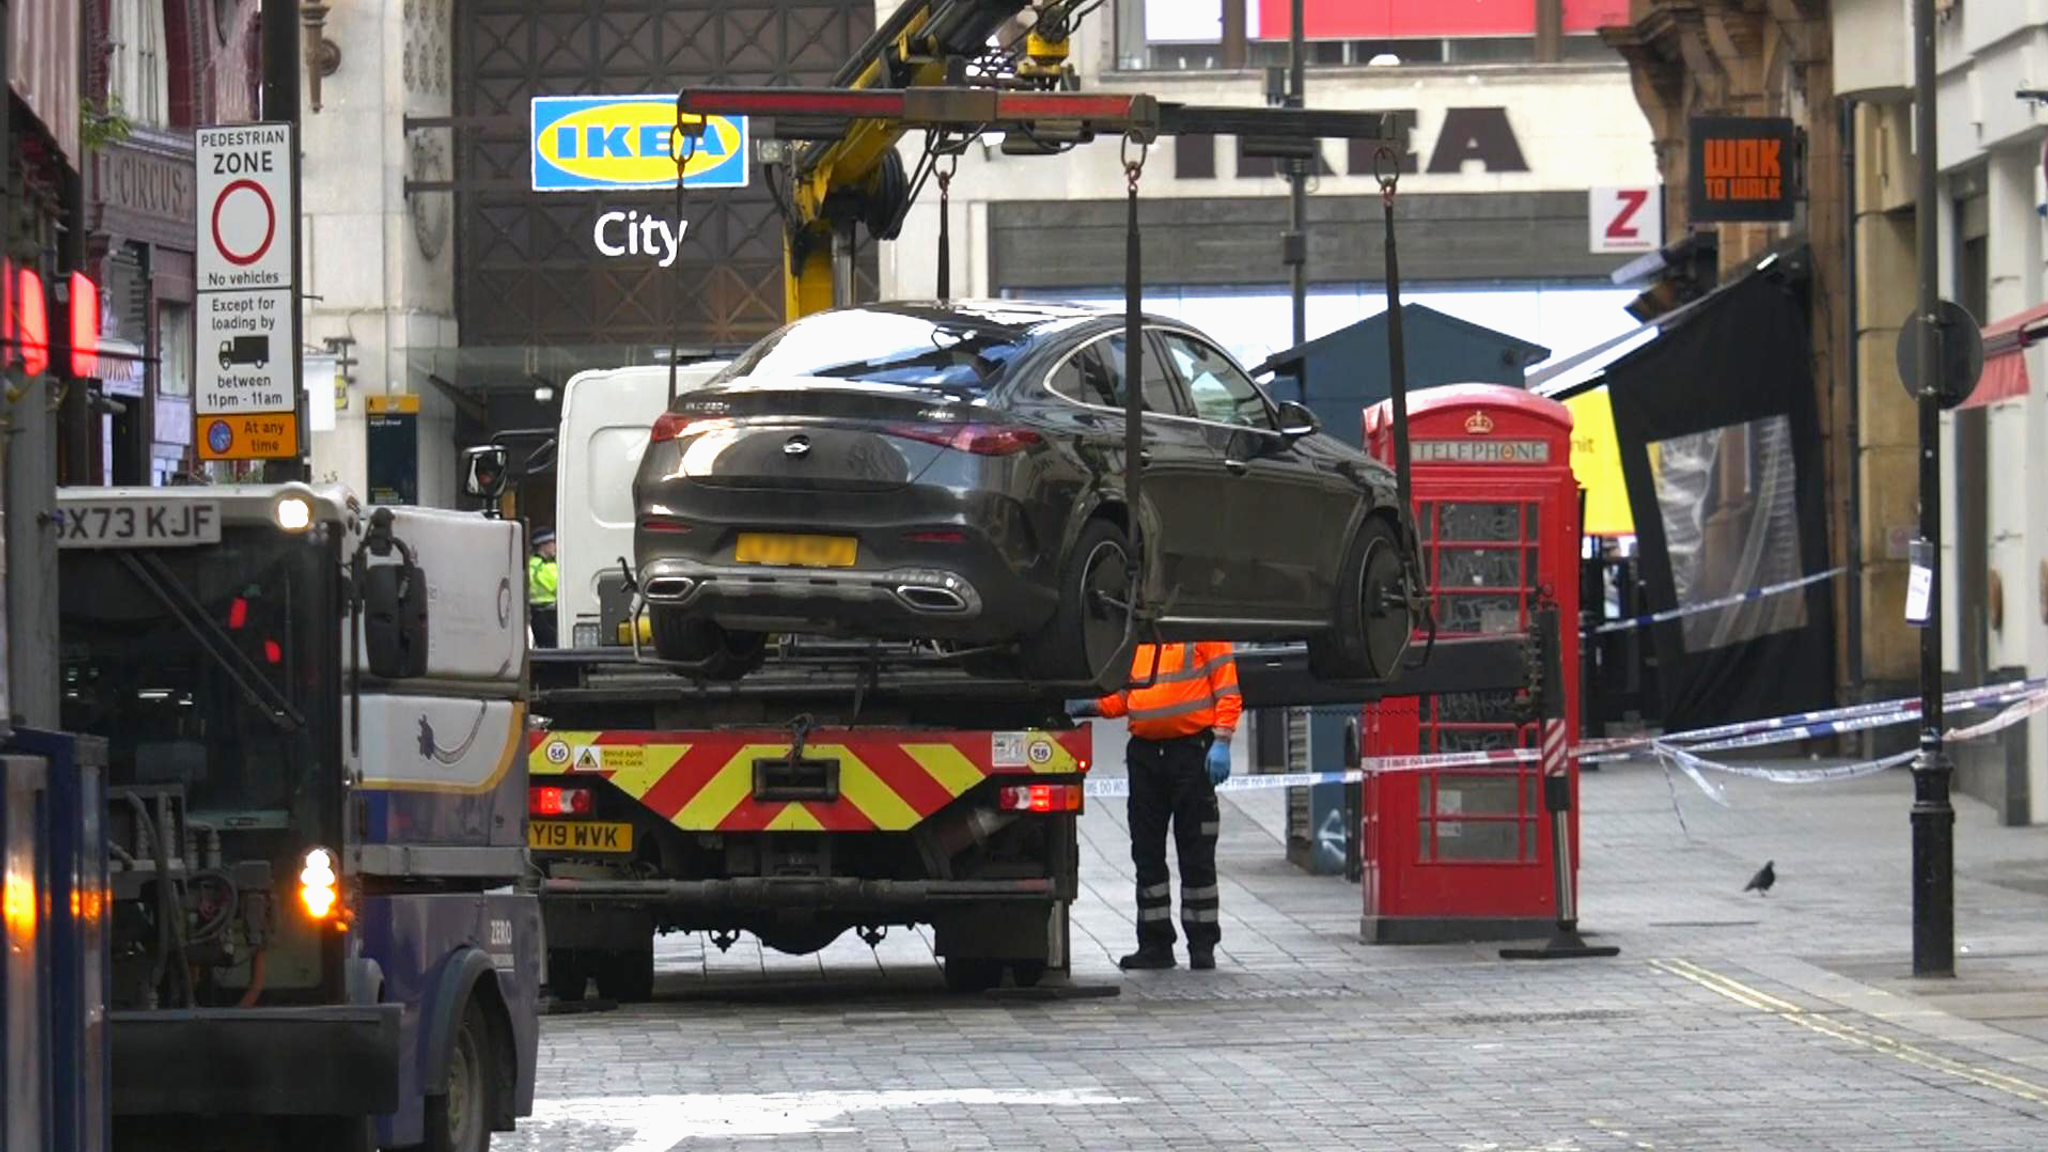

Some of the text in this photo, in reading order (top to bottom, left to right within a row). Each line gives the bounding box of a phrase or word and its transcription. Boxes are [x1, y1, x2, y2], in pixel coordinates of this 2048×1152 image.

[201, 130, 284, 147] PEDESTRIAN
[558, 124, 726, 159] IKEA
[213, 151, 274, 174] ZONE
[1704, 139, 1780, 178] WOK
[1704, 179, 1780, 200] TO WALK
[1605, 191, 1648, 238] Z
[594, 210, 688, 268] City
[208, 271, 279, 286] No vehicles
[212, 297, 275, 314] Except for
[212, 316, 275, 331] loading by
[217, 375, 271, 388] between
[207, 393, 239, 408] 11pm
[252, 392, 283, 405] 11am
[244, 421, 284, 436] At any
[250, 440, 279, 452] time
[1418, 443, 1547, 460] TELEPHONE
[146, 506, 213, 538] KJF
[573, 825, 618, 847] WVK
[490, 920, 512, 945] ZERO
